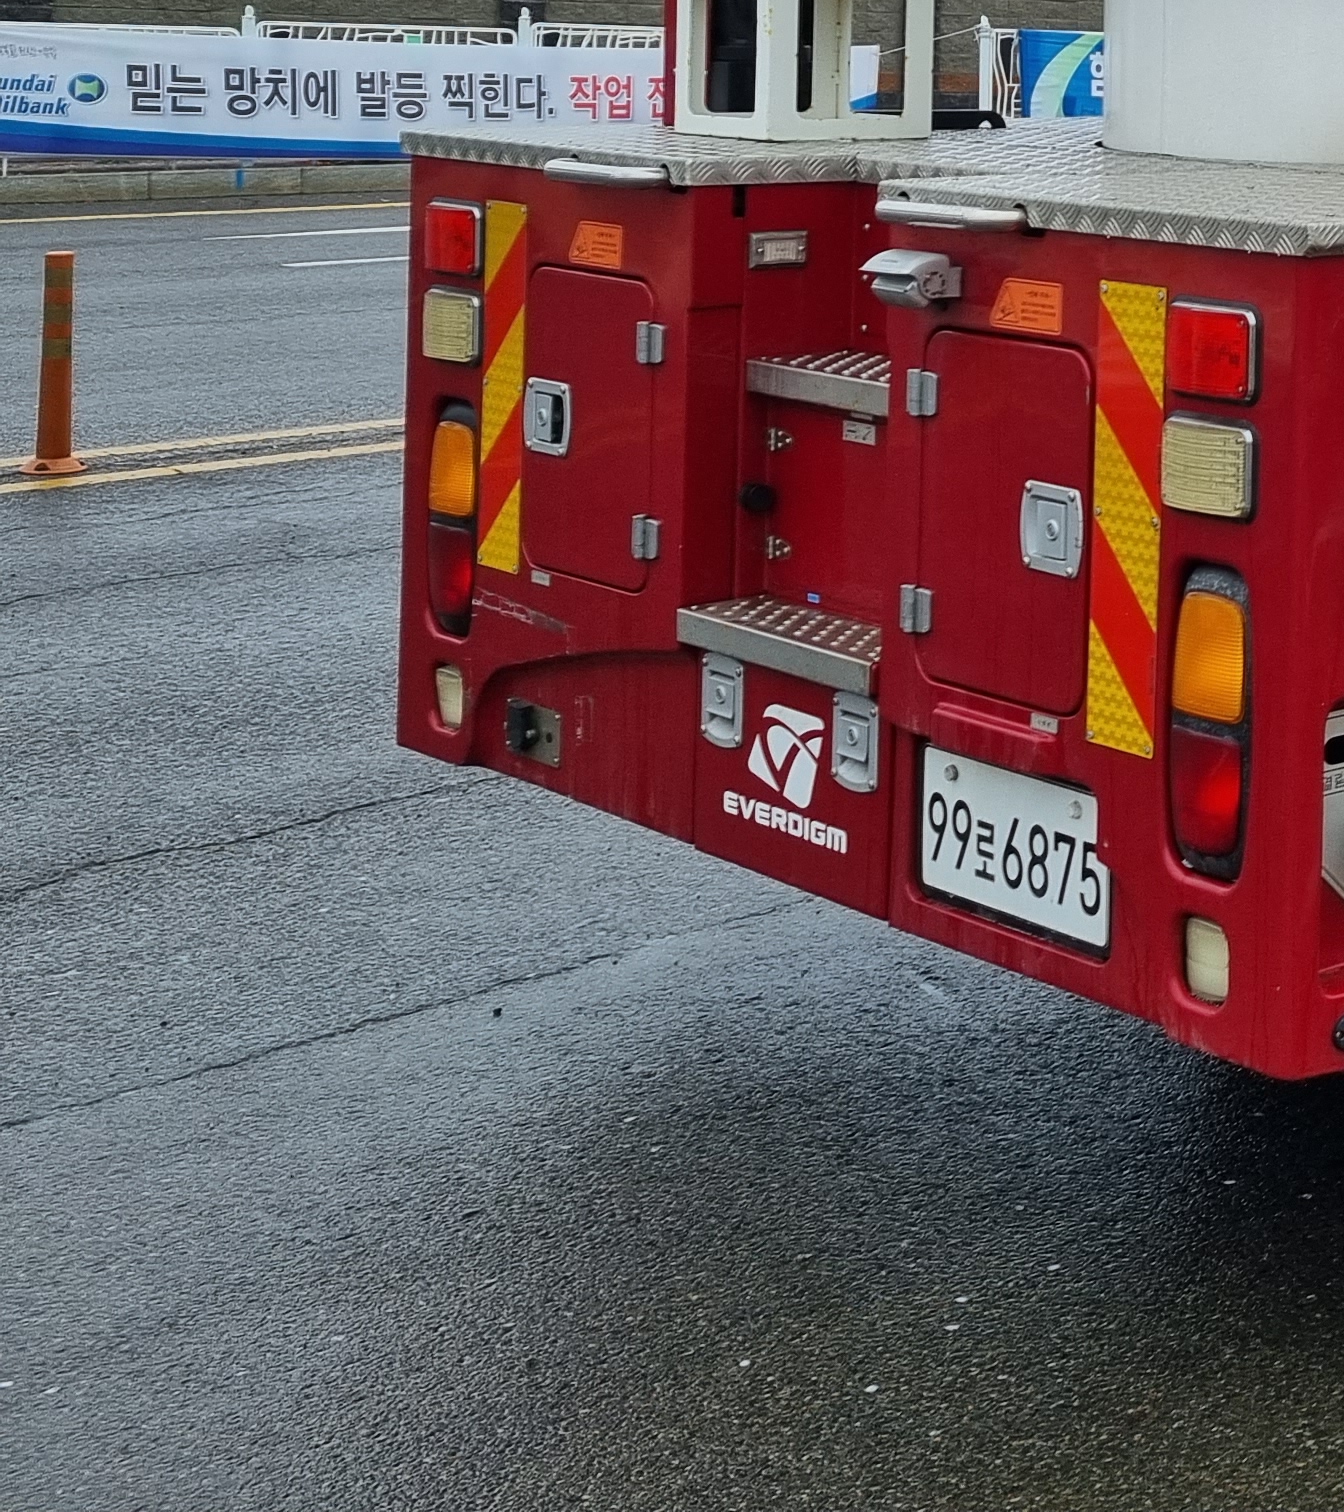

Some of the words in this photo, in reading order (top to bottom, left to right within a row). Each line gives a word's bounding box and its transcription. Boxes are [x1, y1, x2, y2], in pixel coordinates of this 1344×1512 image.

[0, 94, 68, 116] ilbank
[126, 63, 207, 114] 믿는
[223, 66, 339, 119] 망치에
[355, 70, 429, 121] 발등
[441, 71, 556, 121] 찍힌다.
[568, 75, 632, 120] 작업
[723, 790, 848, 855] EVERDIGM
[929, 791, 1101, 916] 99로6875
